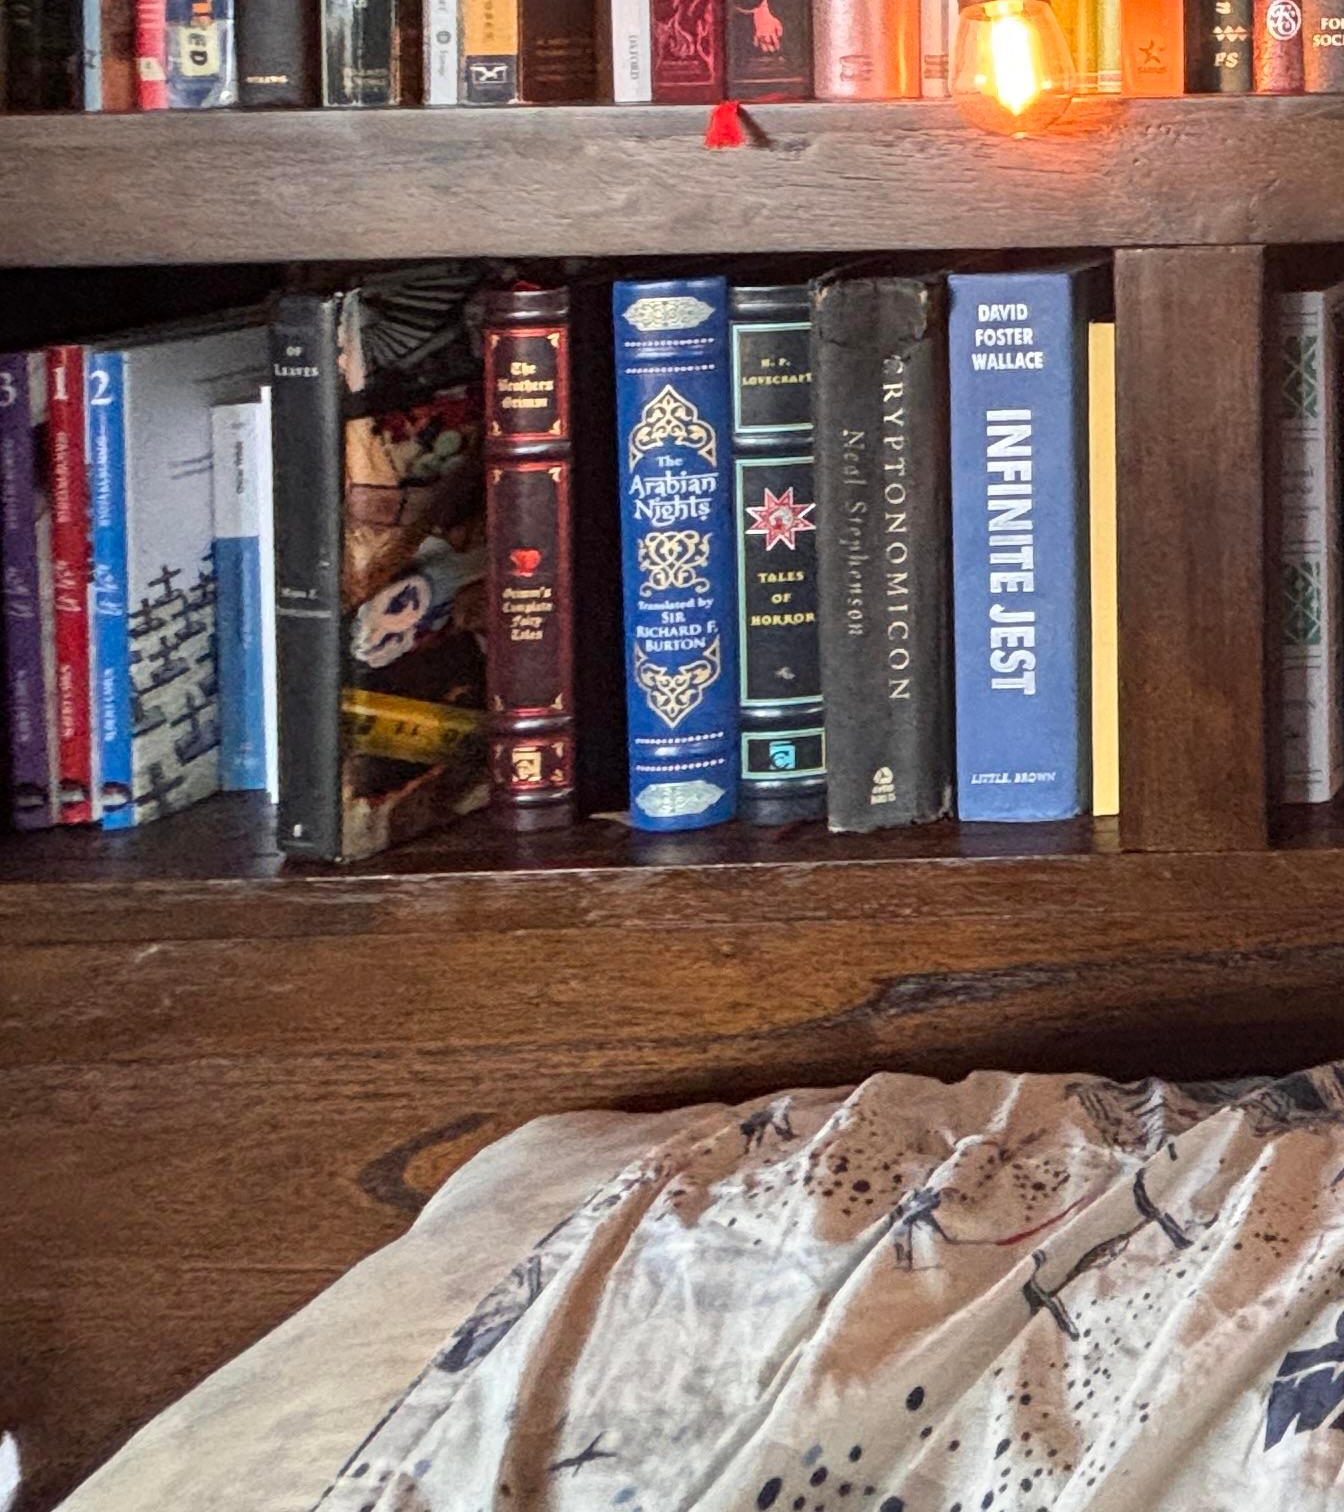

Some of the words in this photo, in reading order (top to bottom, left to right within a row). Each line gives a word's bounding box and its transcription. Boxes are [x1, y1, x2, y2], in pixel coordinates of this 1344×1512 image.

[977, 304, 1028, 322] DAVID
[974, 329, 1033, 347] FOSTER
[971, 351, 1044, 371] WALLACE
[628, 470, 719, 496] Arabian
[985, 408, 1035, 593] INFINITE
[634, 498, 712, 527] Nights
[883, 355, 912, 700] CRYPTONOMICON
[757, 571, 805, 584] TALES
[770, 593, 792, 605] OF
[751, 612, 816, 626] HORROR
[988, 604, 1037, 695] JEST
